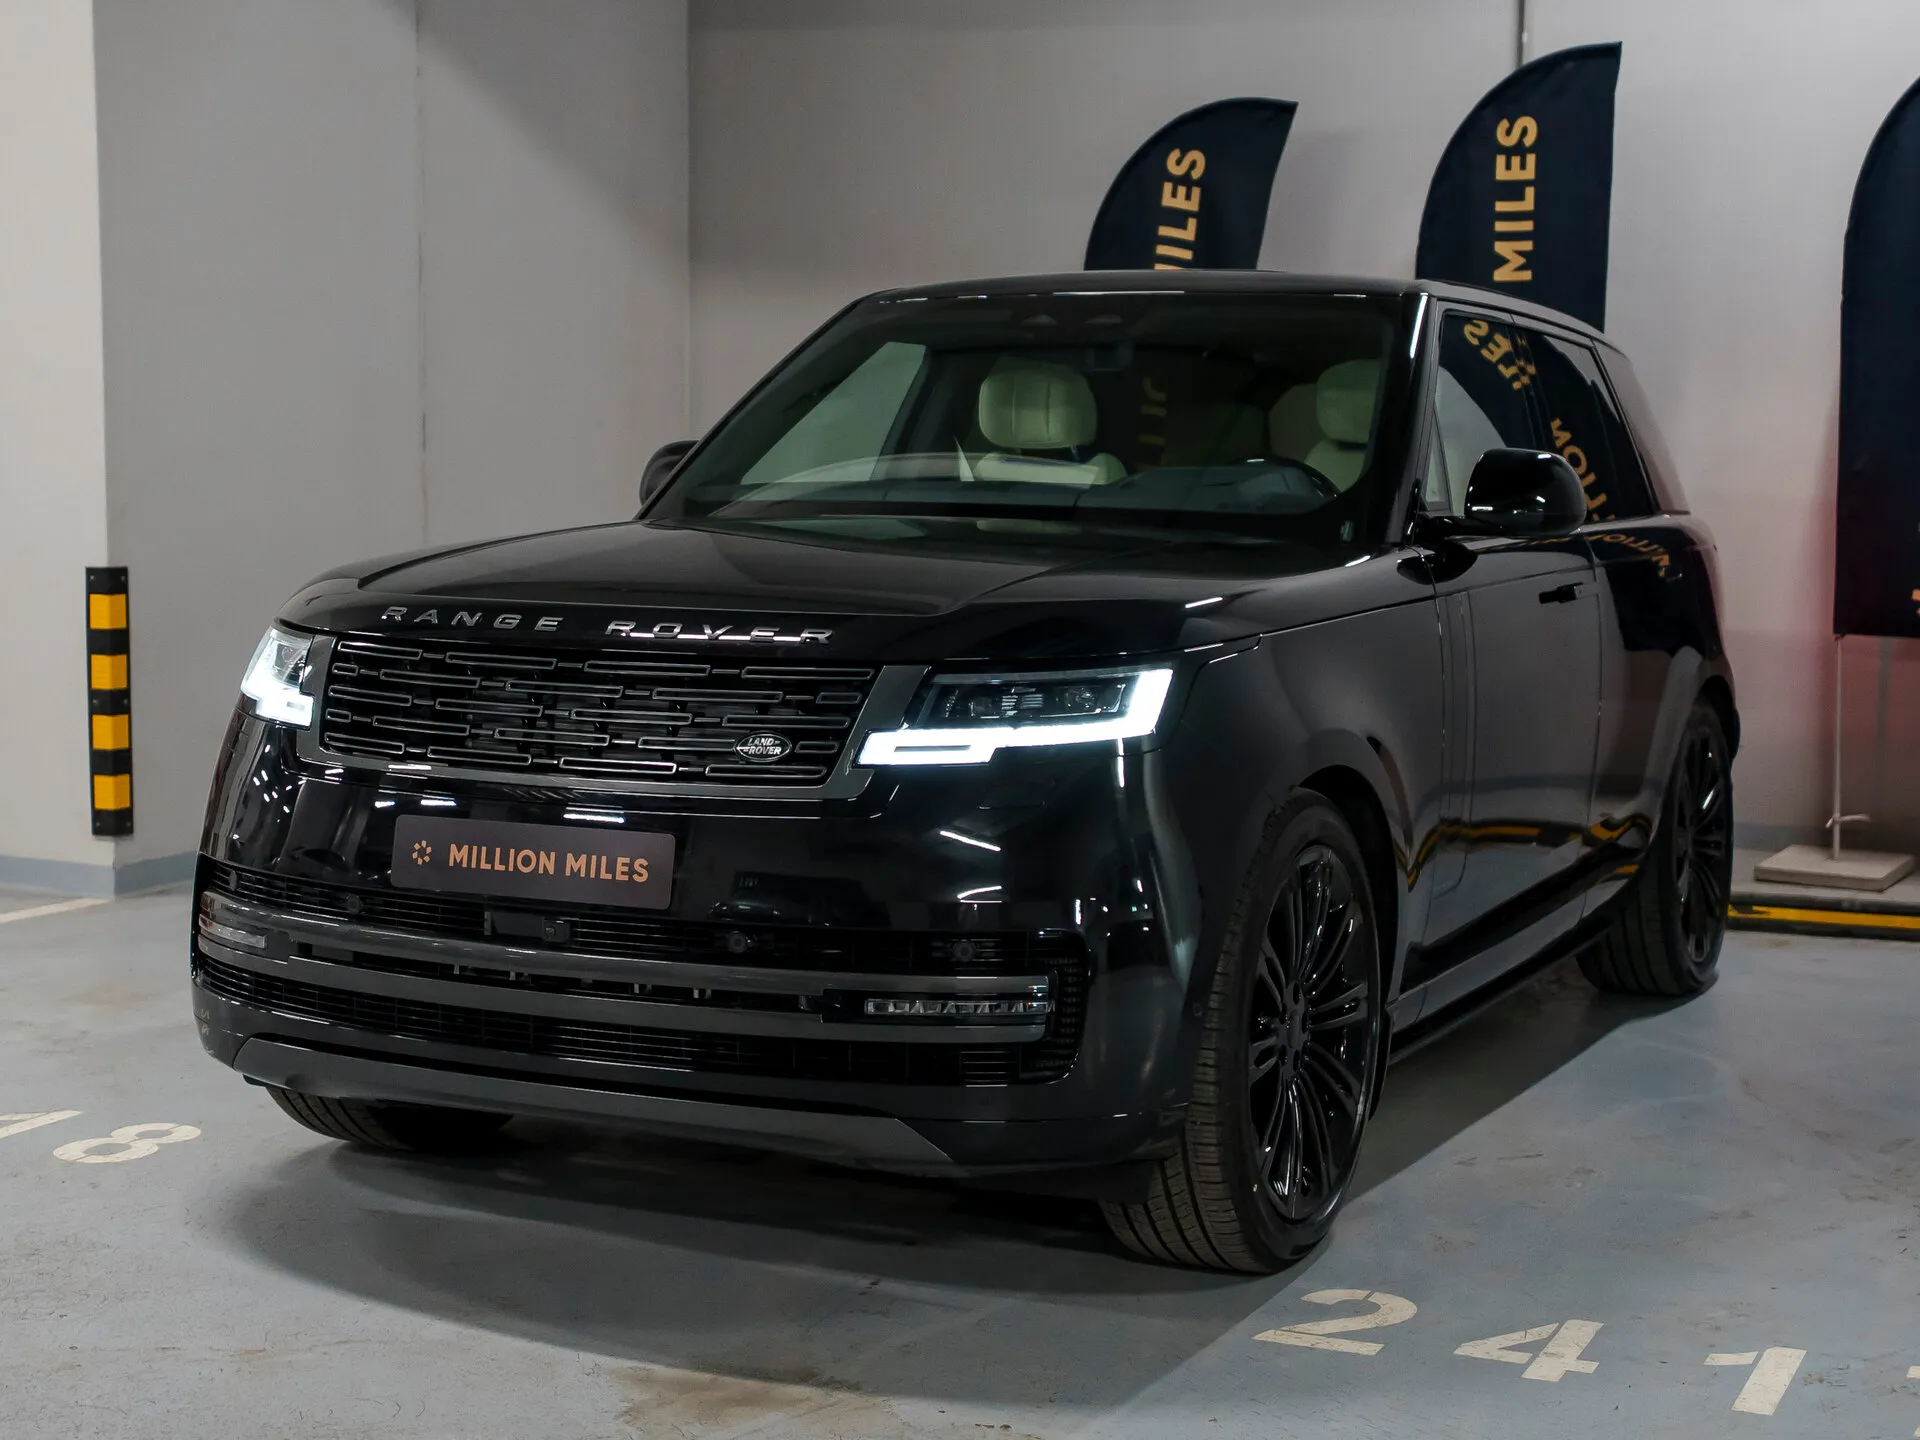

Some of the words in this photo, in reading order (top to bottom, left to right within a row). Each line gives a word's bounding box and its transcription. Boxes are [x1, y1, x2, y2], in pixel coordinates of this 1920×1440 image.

[1153, 148, 1207, 271] ILES
[1493, 115, 1539, 283] MILES
[381, 605, 564, 632] RANGE
[605, 620, 834, 645] ROVER
[747, 737, 775, 746] LAND
[748, 746, 782, 755] ROVER
[448, 843, 556, 876] MILLION
[565, 852, 650, 883] MILES
